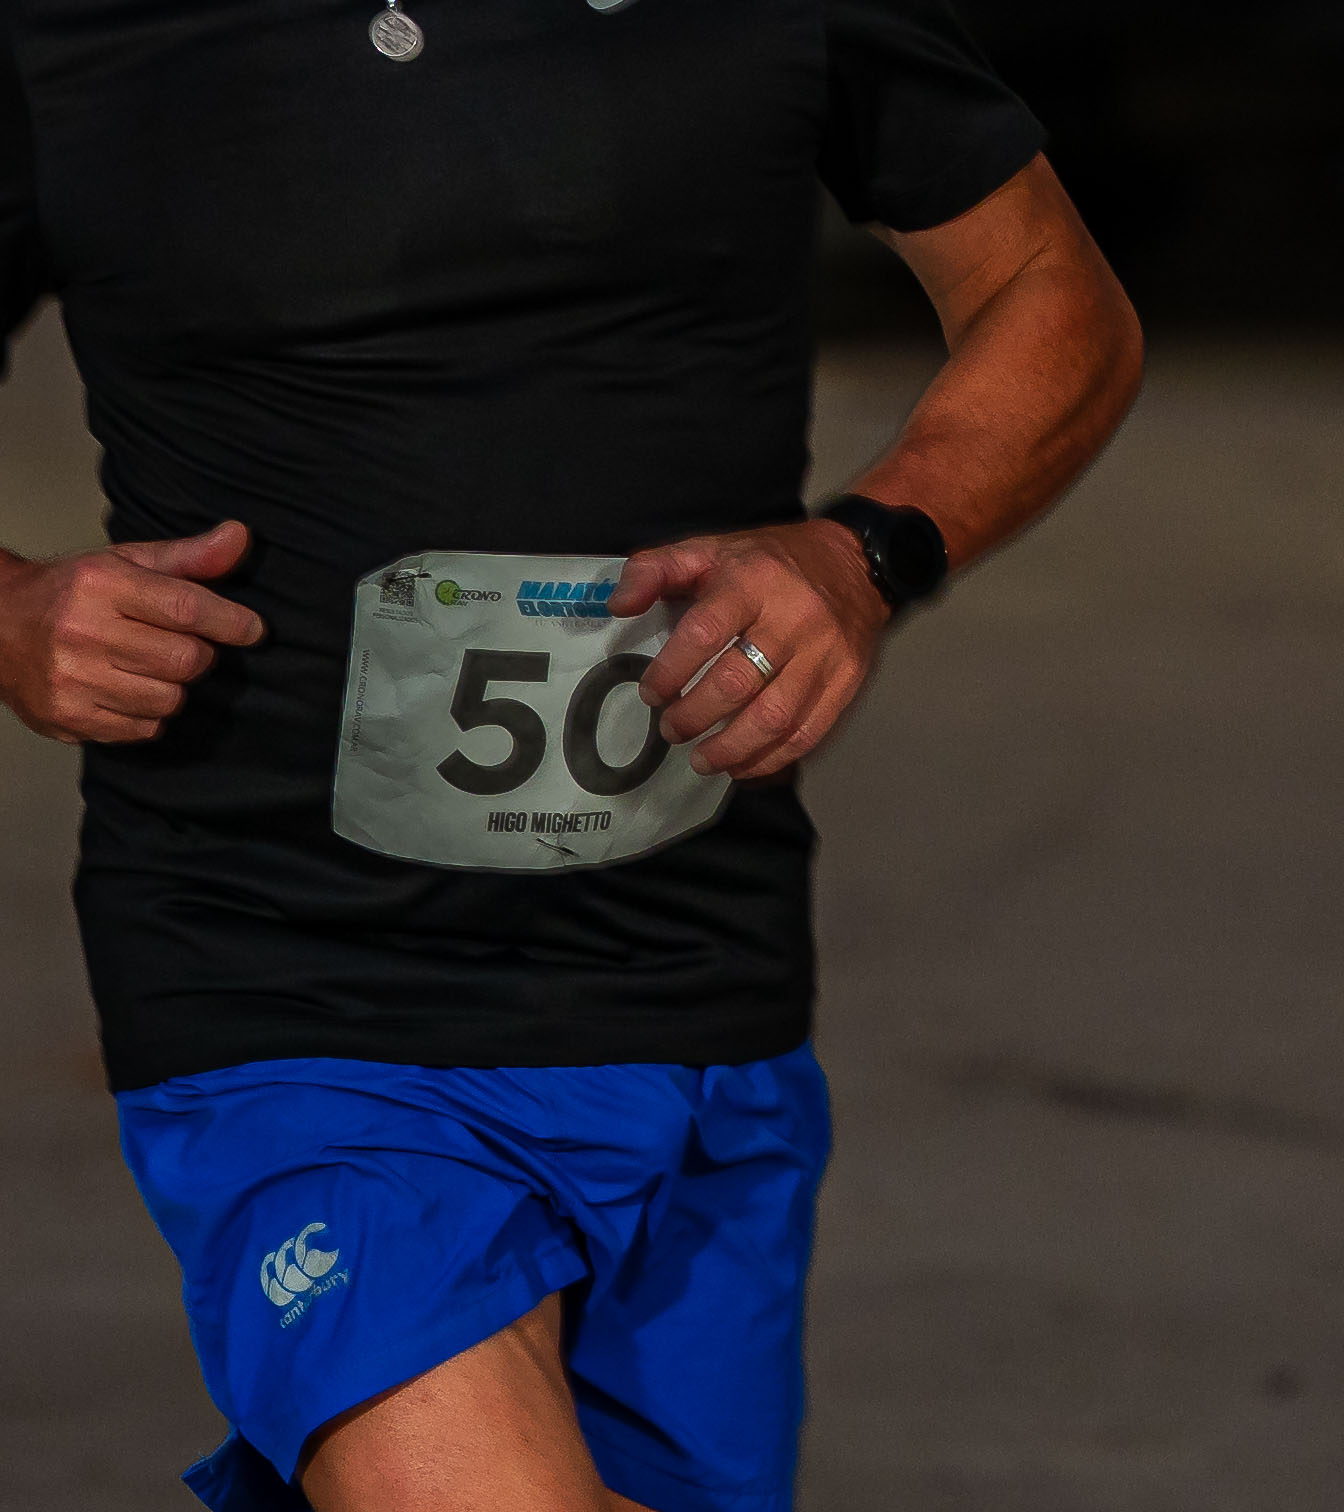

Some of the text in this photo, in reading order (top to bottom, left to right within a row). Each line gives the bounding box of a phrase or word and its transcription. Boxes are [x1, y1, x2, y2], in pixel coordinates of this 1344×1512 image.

[453, 589, 502, 602] CRONO
[435, 648, 674, 797] 50
[487, 810, 612, 833] HIGO MIGHETTO
